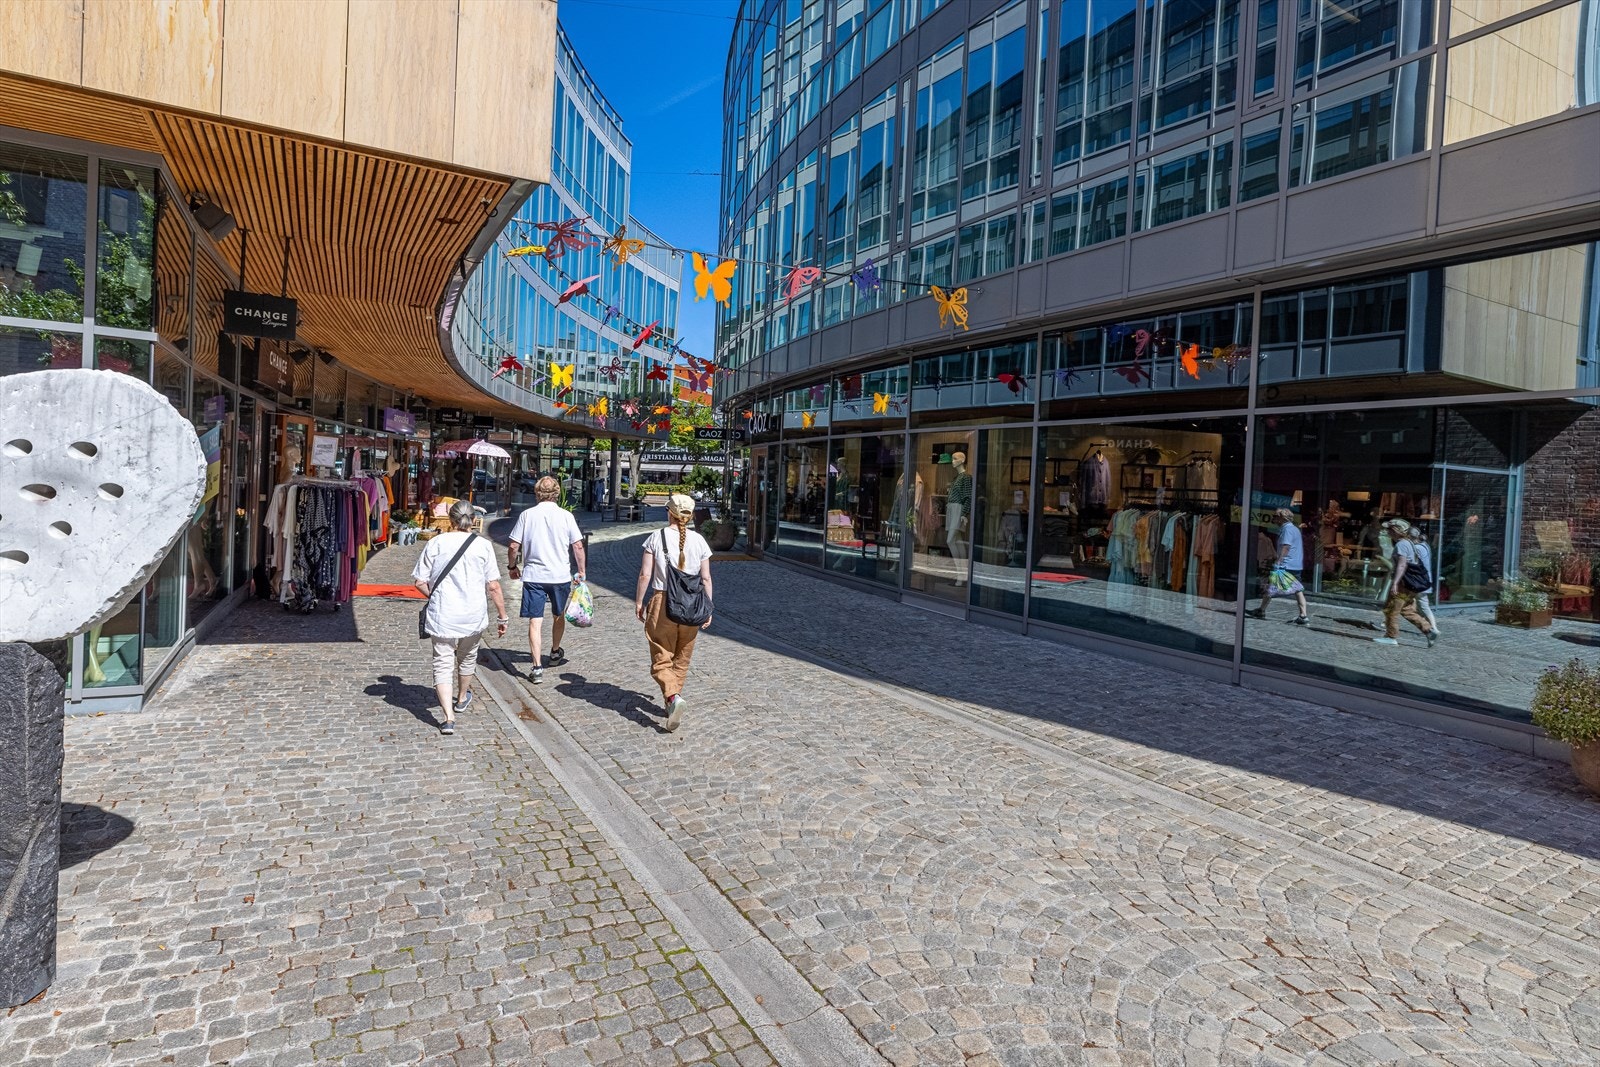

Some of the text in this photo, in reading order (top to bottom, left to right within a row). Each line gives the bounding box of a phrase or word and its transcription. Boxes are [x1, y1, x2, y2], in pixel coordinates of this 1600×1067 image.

[234, 307, 288, 321] CHANGE
[748, 412, 767, 434] CAOZ
[699, 429, 723, 439] CAOZ
